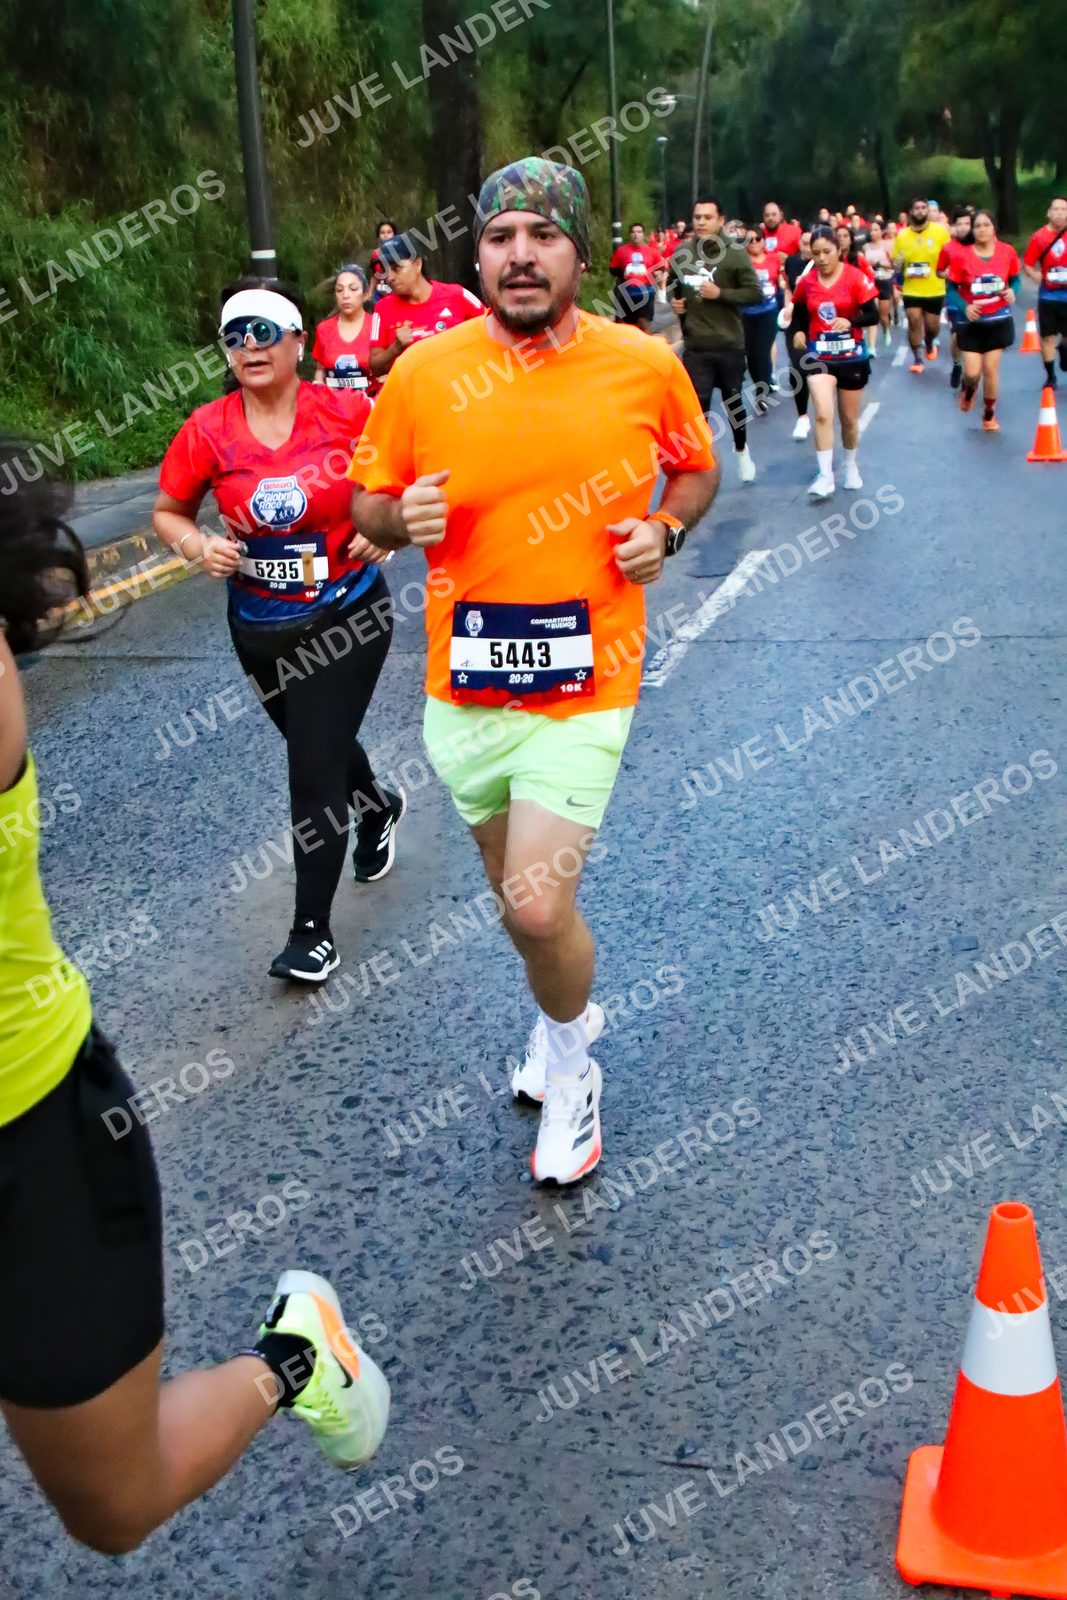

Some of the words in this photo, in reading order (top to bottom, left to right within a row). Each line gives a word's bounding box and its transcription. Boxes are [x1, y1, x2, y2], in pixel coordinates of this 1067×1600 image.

[259, 501, 282, 510] Race
[255, 561, 299, 580] 5235
[490, 641, 552, 668] 5443
[560, 683, 583, 693] 10K
